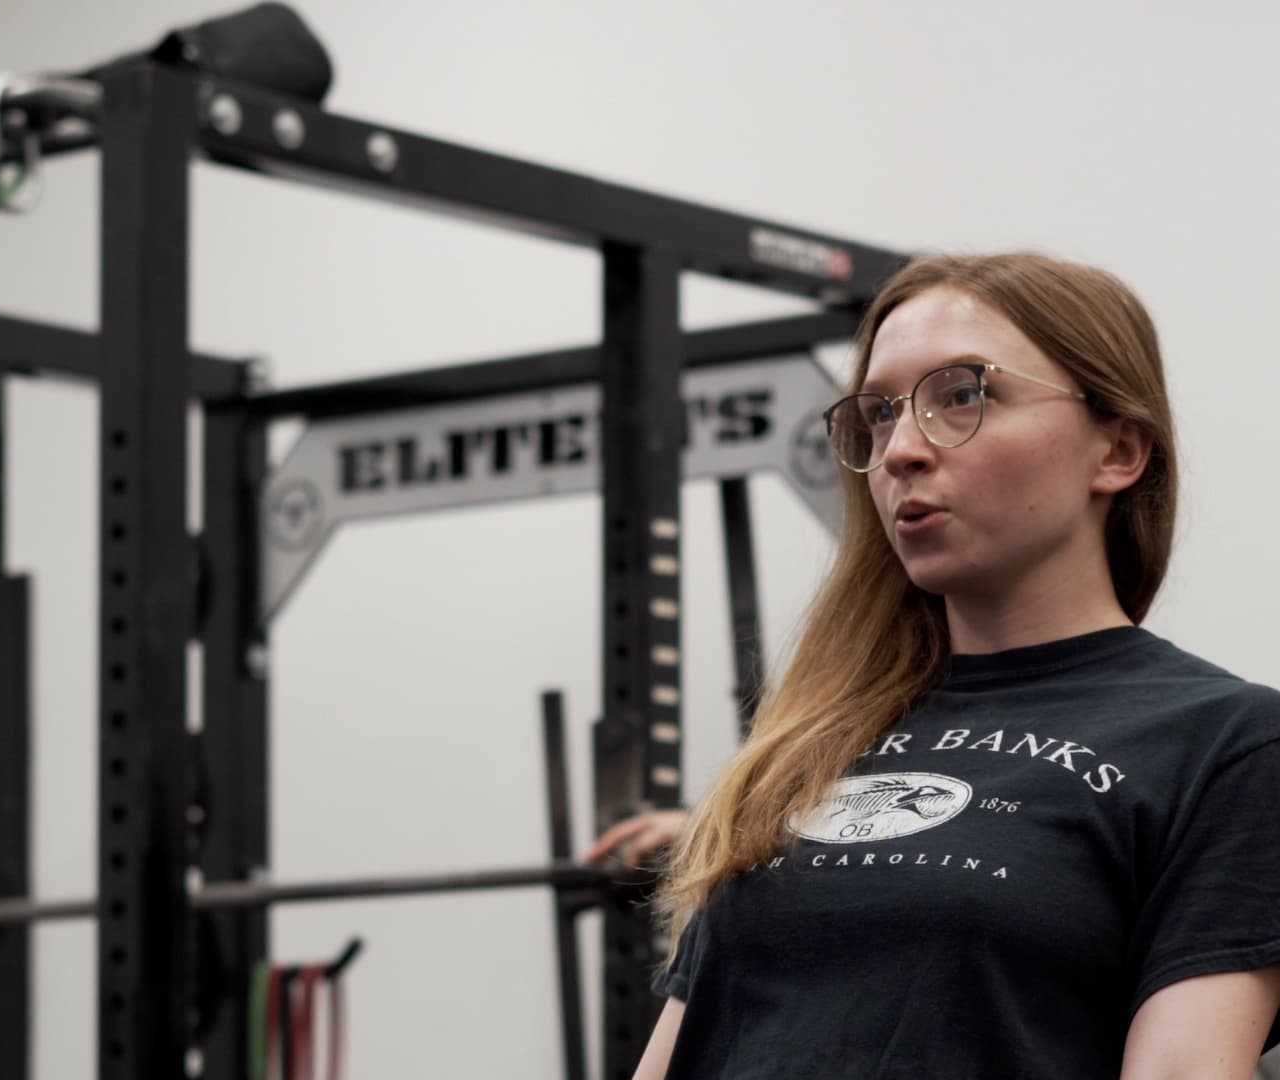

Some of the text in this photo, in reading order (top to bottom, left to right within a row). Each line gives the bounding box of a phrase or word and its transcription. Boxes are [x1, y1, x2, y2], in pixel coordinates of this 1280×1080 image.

[338, 388, 772, 494] ELITES
[930, 727, 1127, 793] BANKS
[978, 798, 1022, 814] 1876
[838, 823, 874, 838] OB
[812, 853, 1008, 879] CAROLINA
